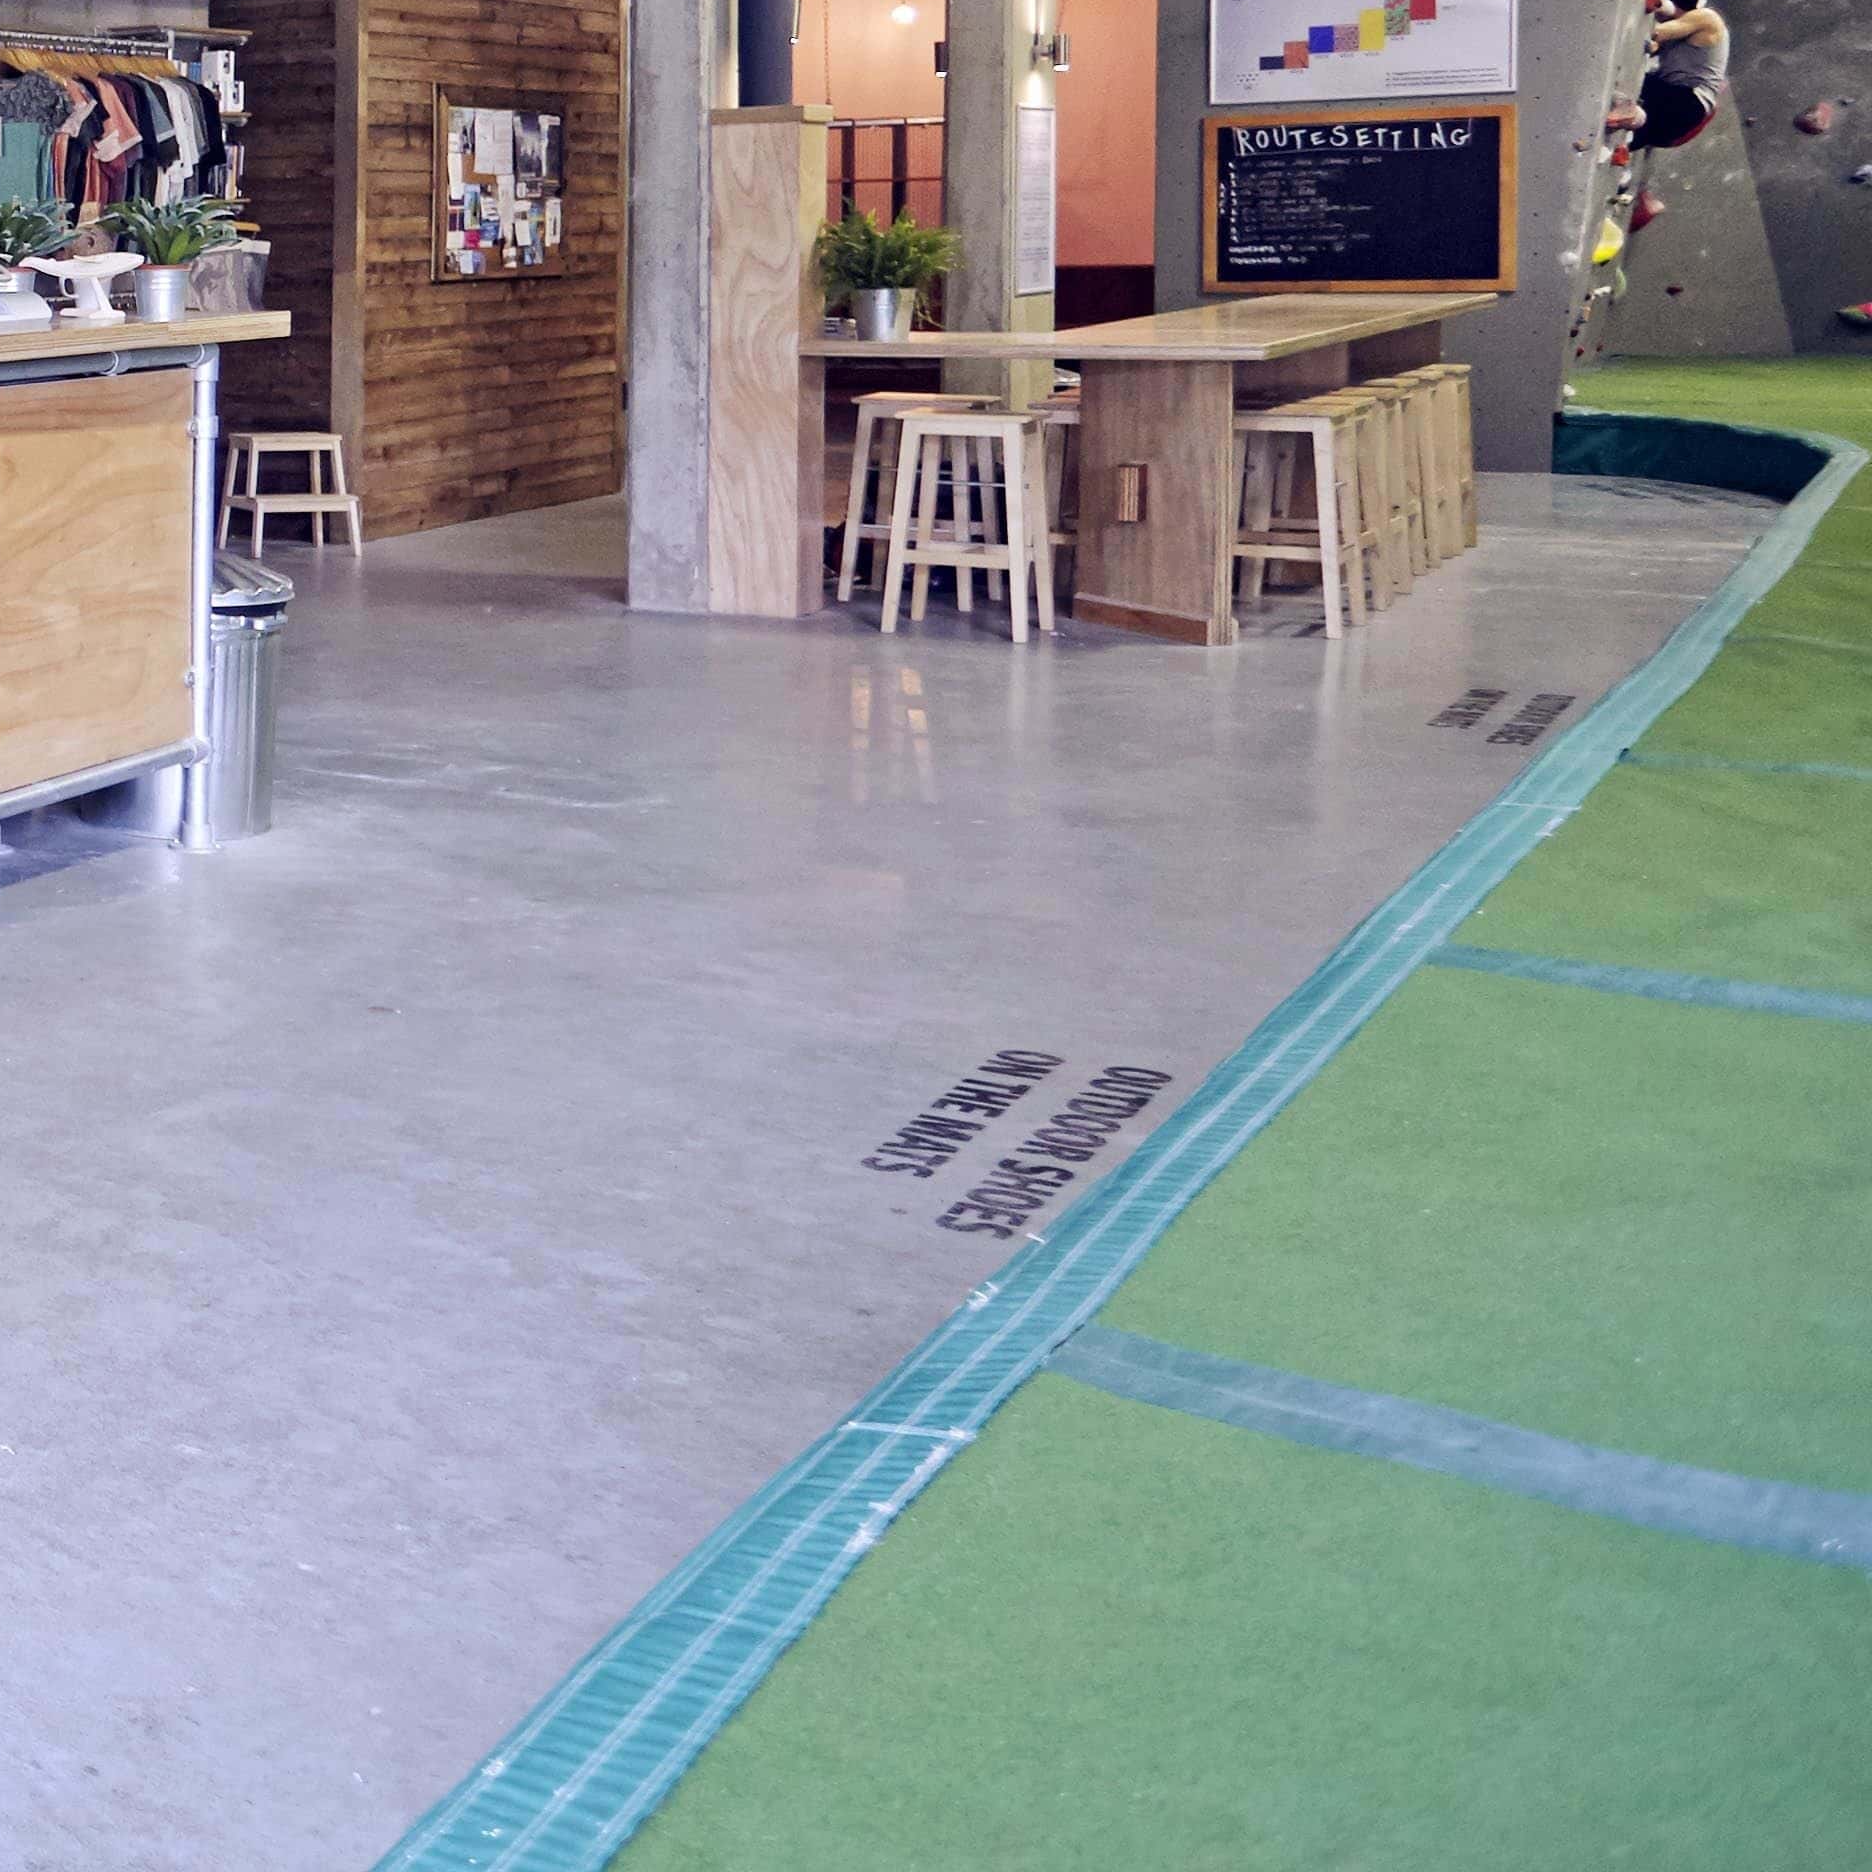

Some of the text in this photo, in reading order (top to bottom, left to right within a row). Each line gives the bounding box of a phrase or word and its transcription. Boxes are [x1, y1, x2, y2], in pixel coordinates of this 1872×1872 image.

[860, 1050, 1066, 1179] ON THE MATS
[936, 1066, 1173, 1240] OUTDOOR SHOES
